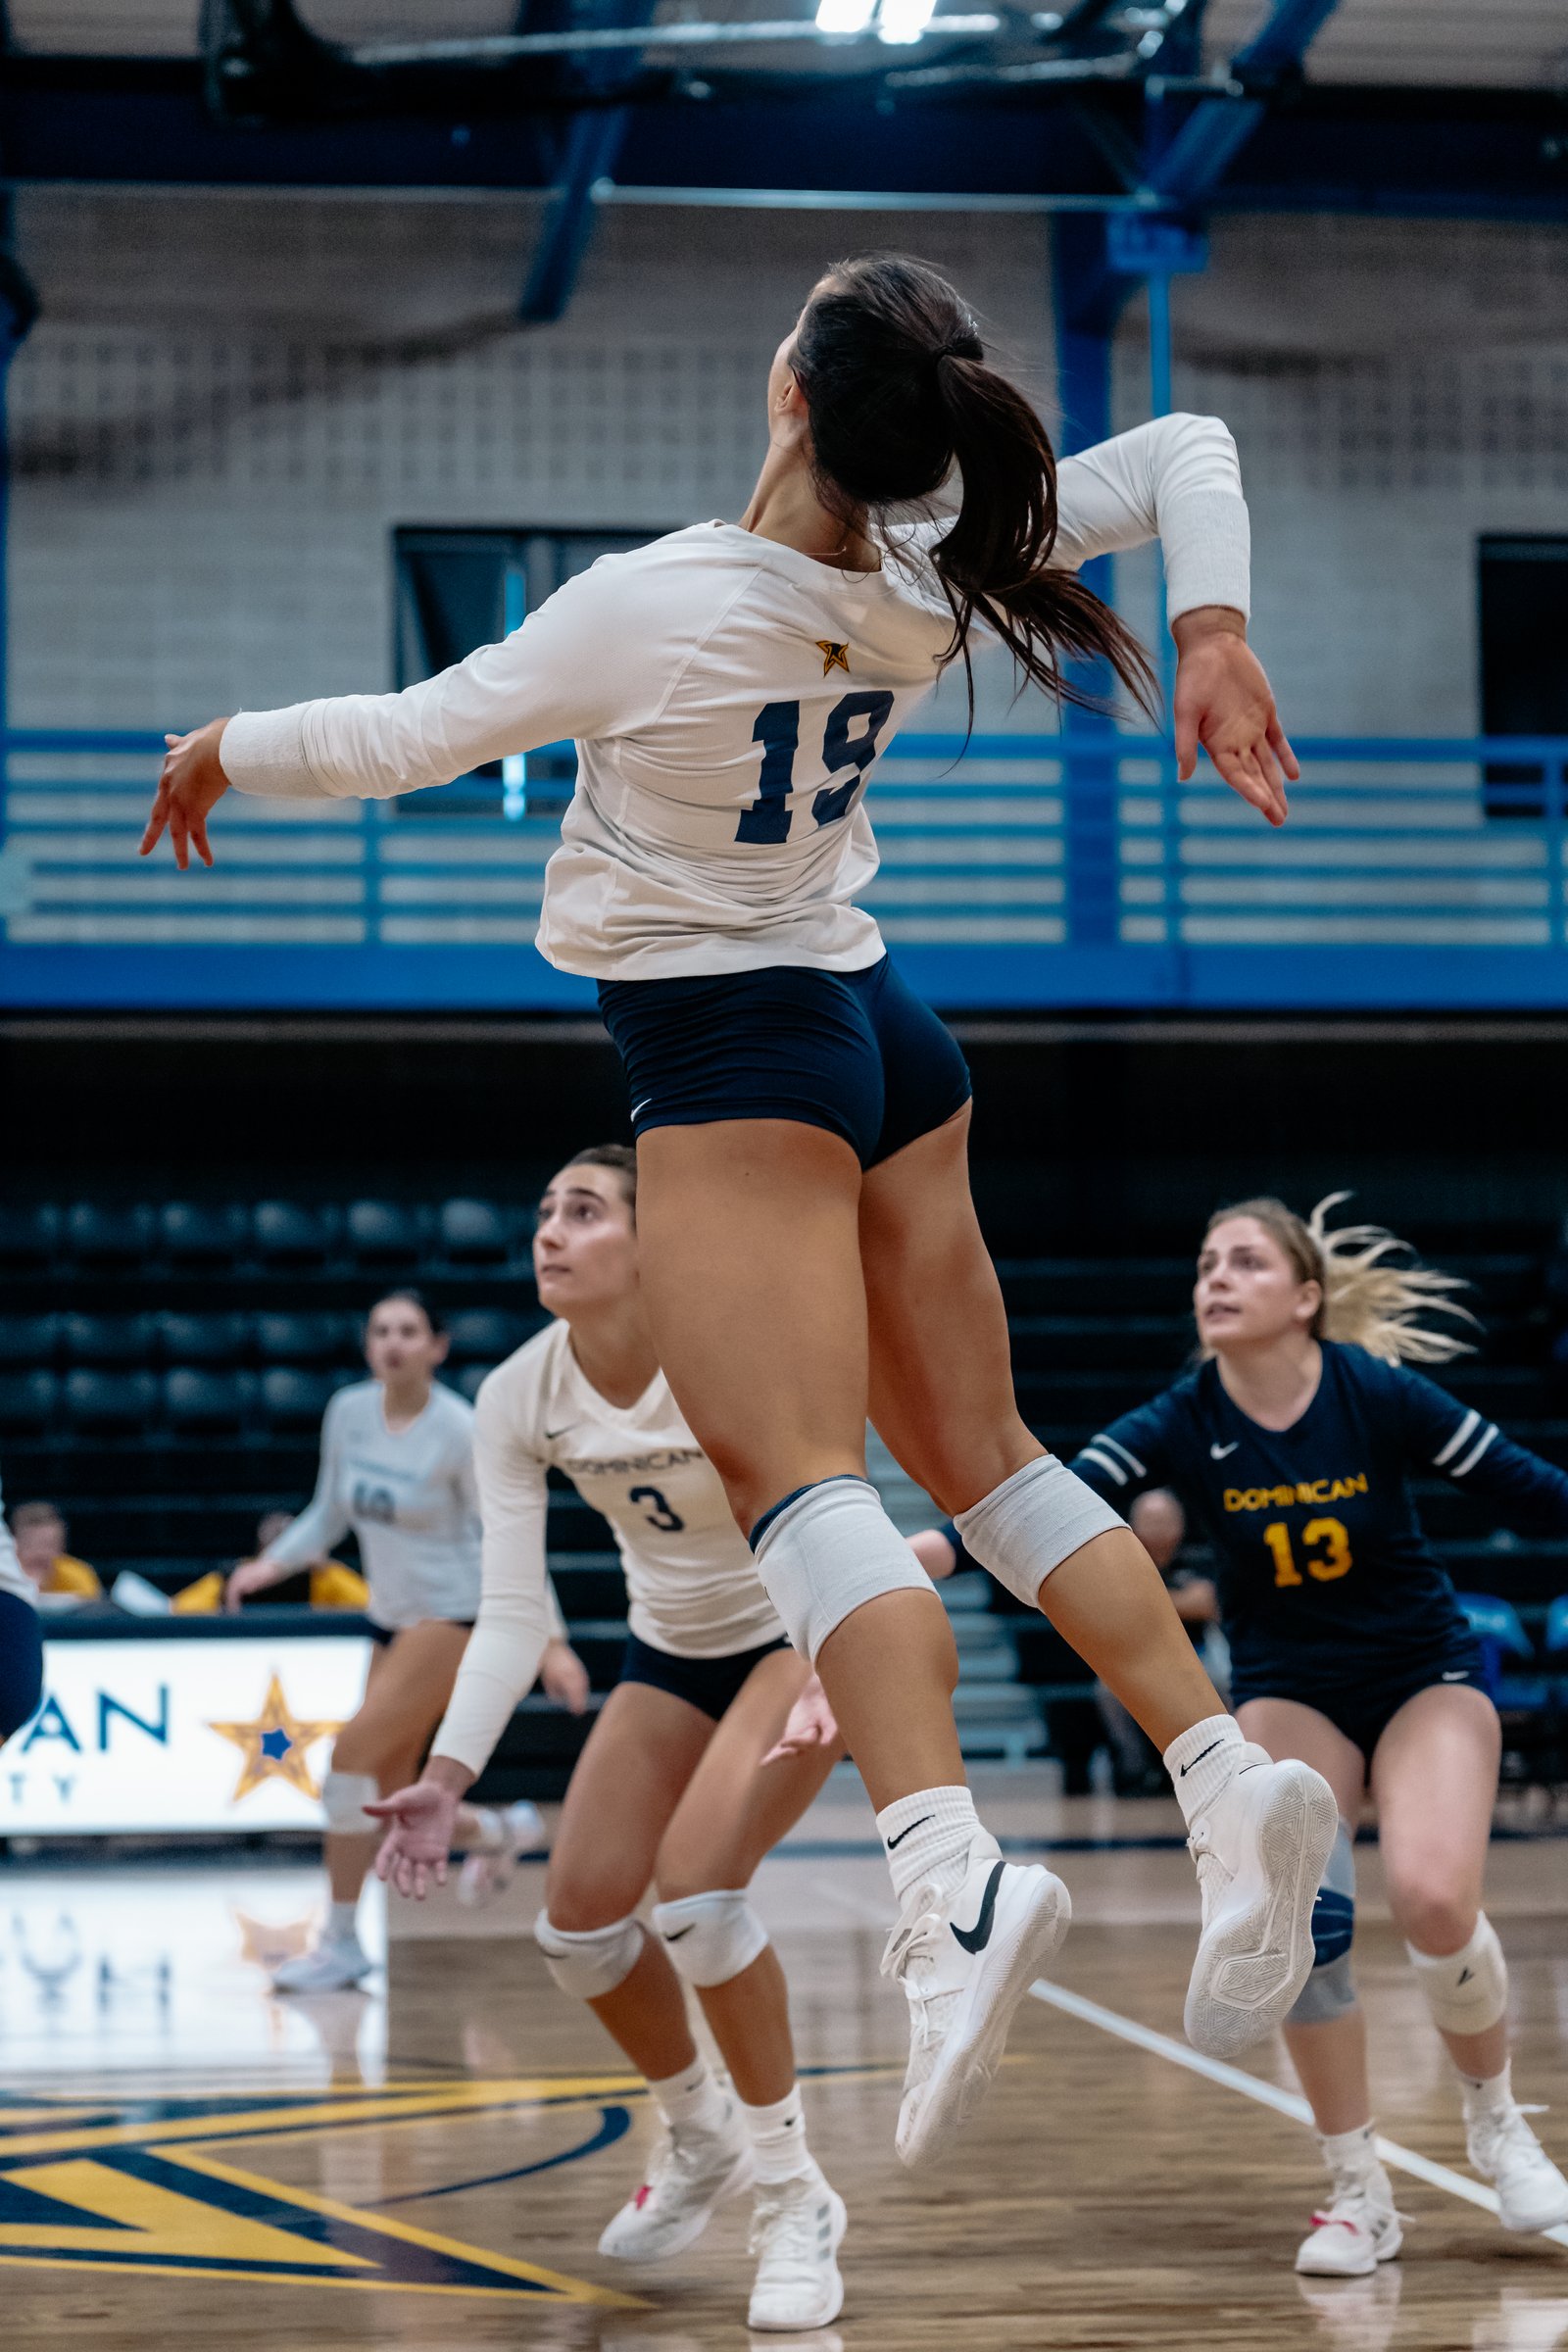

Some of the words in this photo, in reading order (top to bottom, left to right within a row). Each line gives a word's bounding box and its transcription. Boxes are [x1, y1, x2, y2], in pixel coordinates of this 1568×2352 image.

[734, 690, 895, 844] 19
[629, 1486, 684, 1532] 3
[1223, 1472, 1368, 1512] DOMINICAN
[1263, 1516, 1352, 1588] 13
